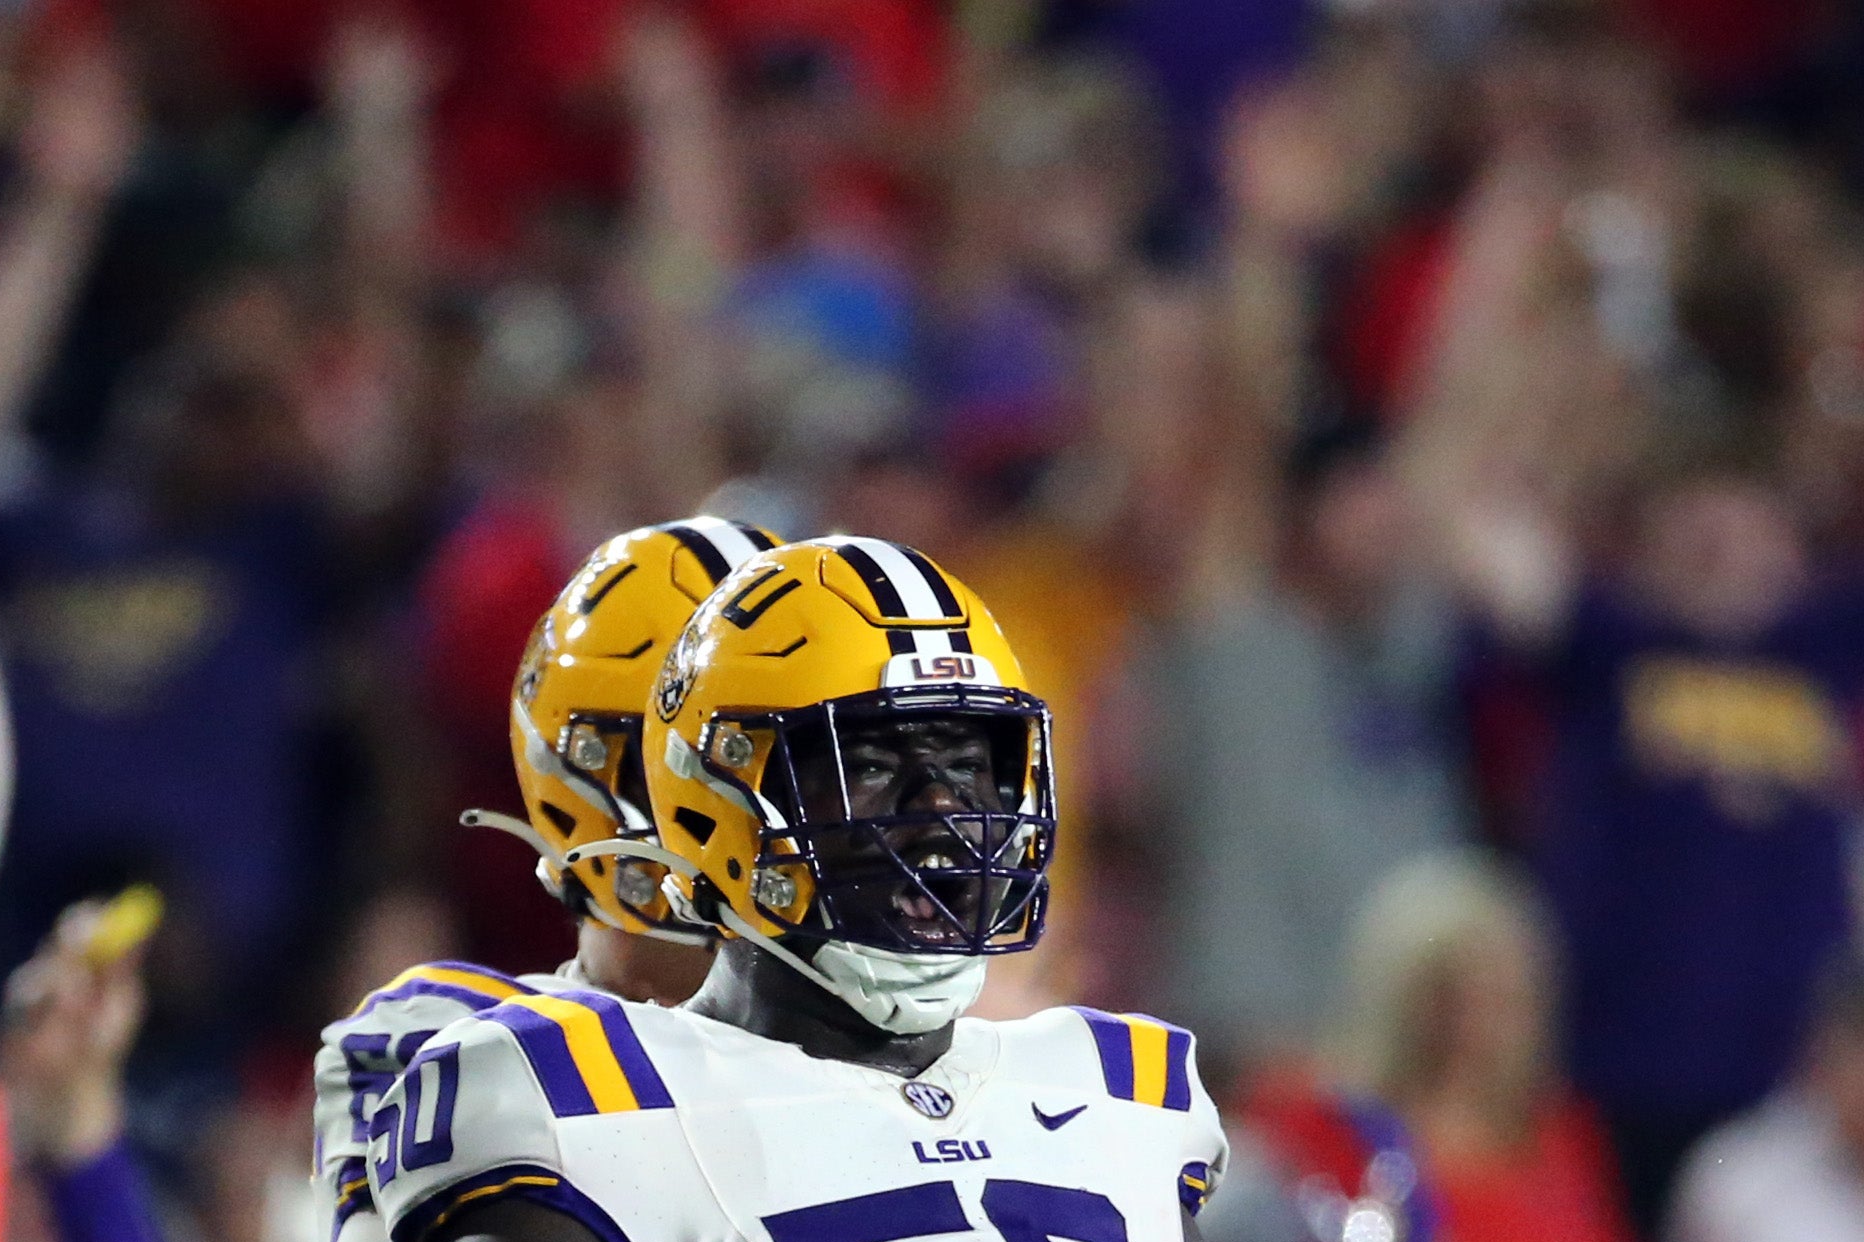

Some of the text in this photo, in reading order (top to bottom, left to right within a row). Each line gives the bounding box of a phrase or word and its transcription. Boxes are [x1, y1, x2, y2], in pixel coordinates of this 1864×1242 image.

[910, 656, 976, 680] LSU
[904, 1082, 953, 1117] SEC
[912, 1139, 992, 1164] LSU
